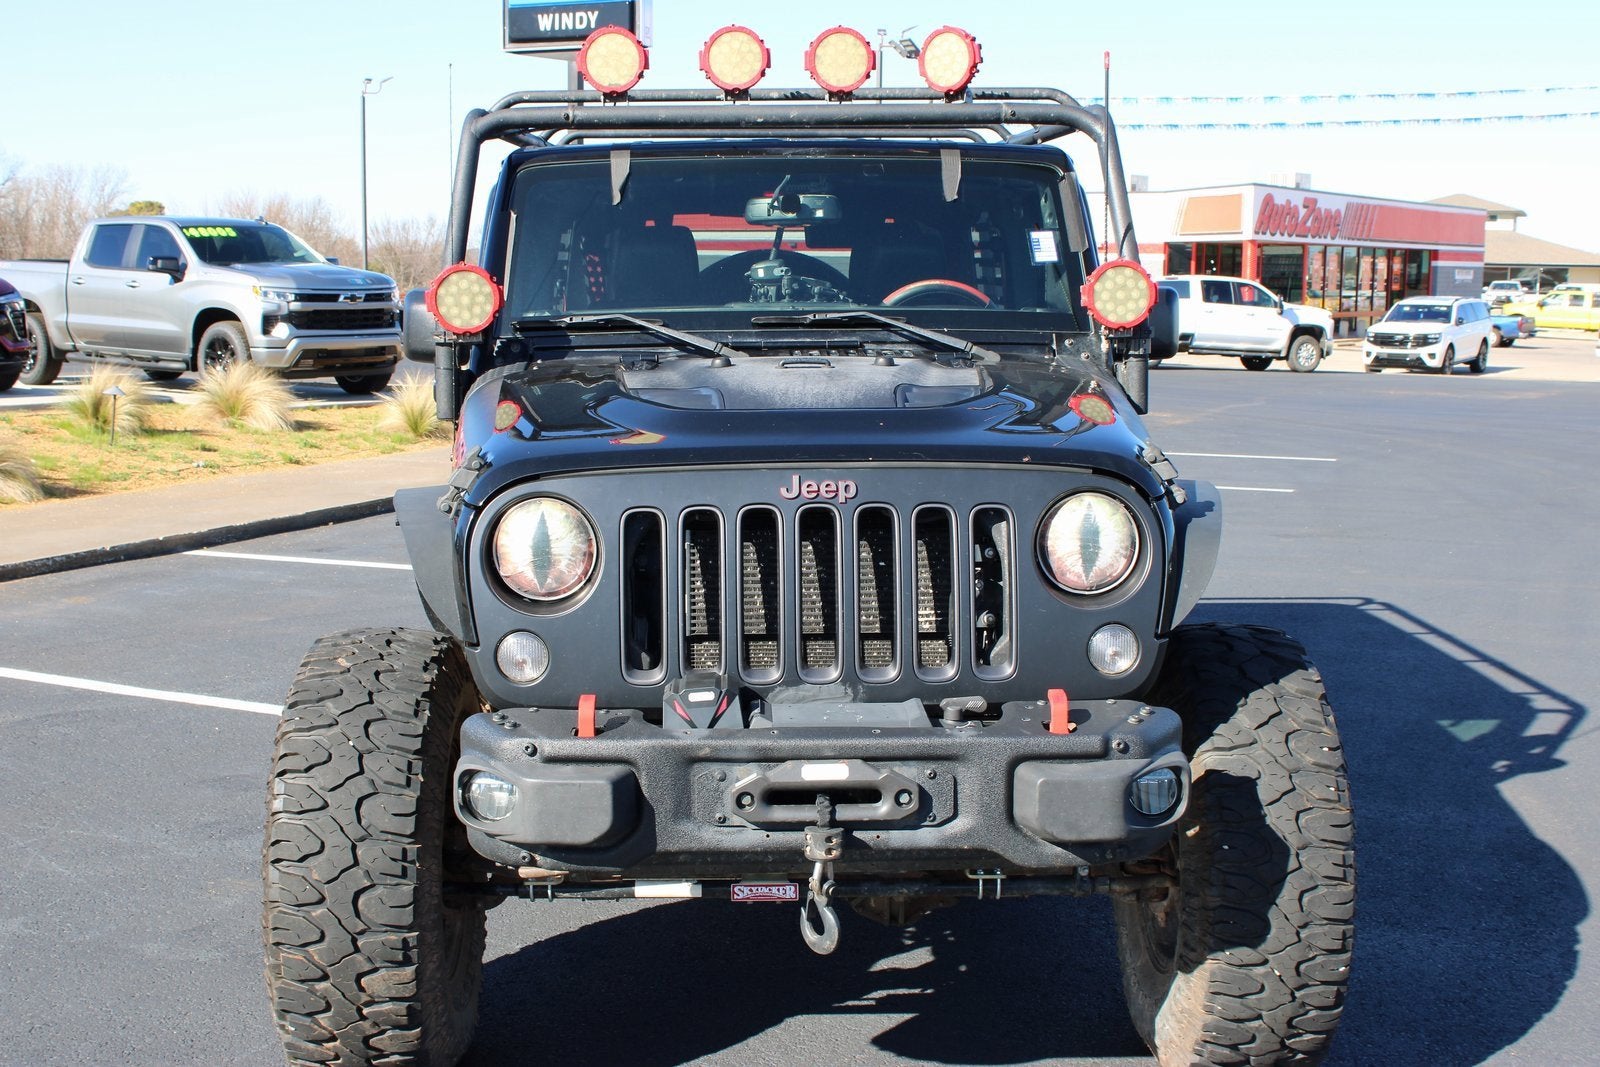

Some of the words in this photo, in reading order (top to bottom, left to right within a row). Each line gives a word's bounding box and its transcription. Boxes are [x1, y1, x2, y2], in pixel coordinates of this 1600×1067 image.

[537, 10, 600, 32] WINDY
[1254, 192, 1343, 240] AutoZone
[779, 474, 859, 504] Jeep
